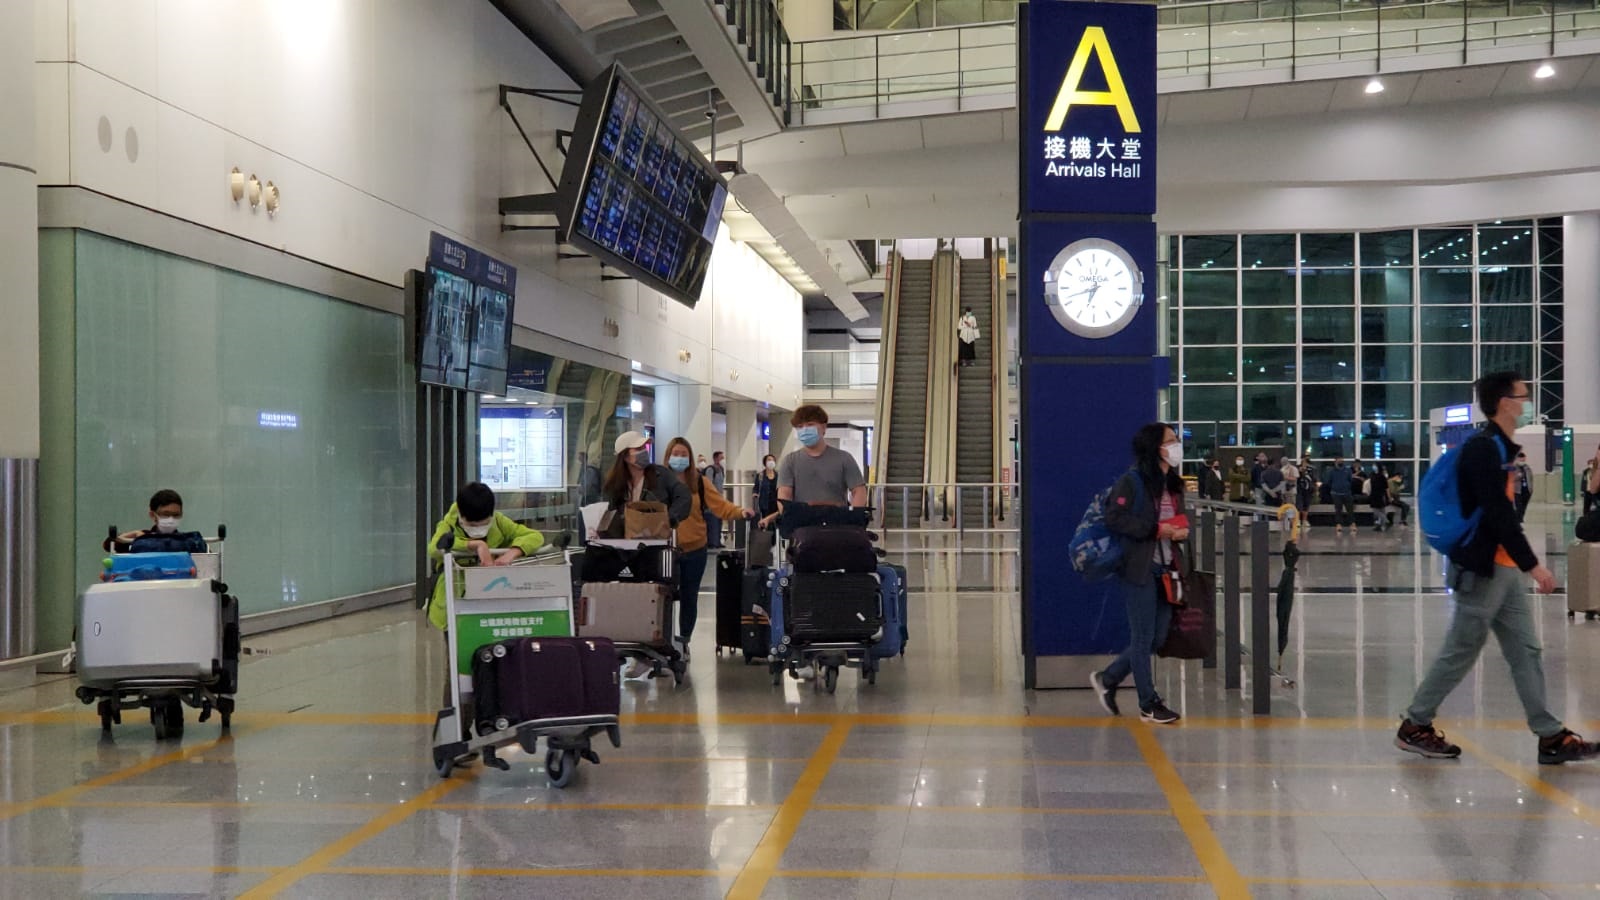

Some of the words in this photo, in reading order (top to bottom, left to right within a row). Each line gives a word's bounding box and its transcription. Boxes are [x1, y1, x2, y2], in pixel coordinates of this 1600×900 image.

[1043, 26, 1142, 133] A
[1044, 135, 1141, 160] 接機大堂
[1045, 161, 1106, 177] Arrivals
[1111, 162, 1141, 178] Hall
[1078, 275, 1109, 283] OMEGA
